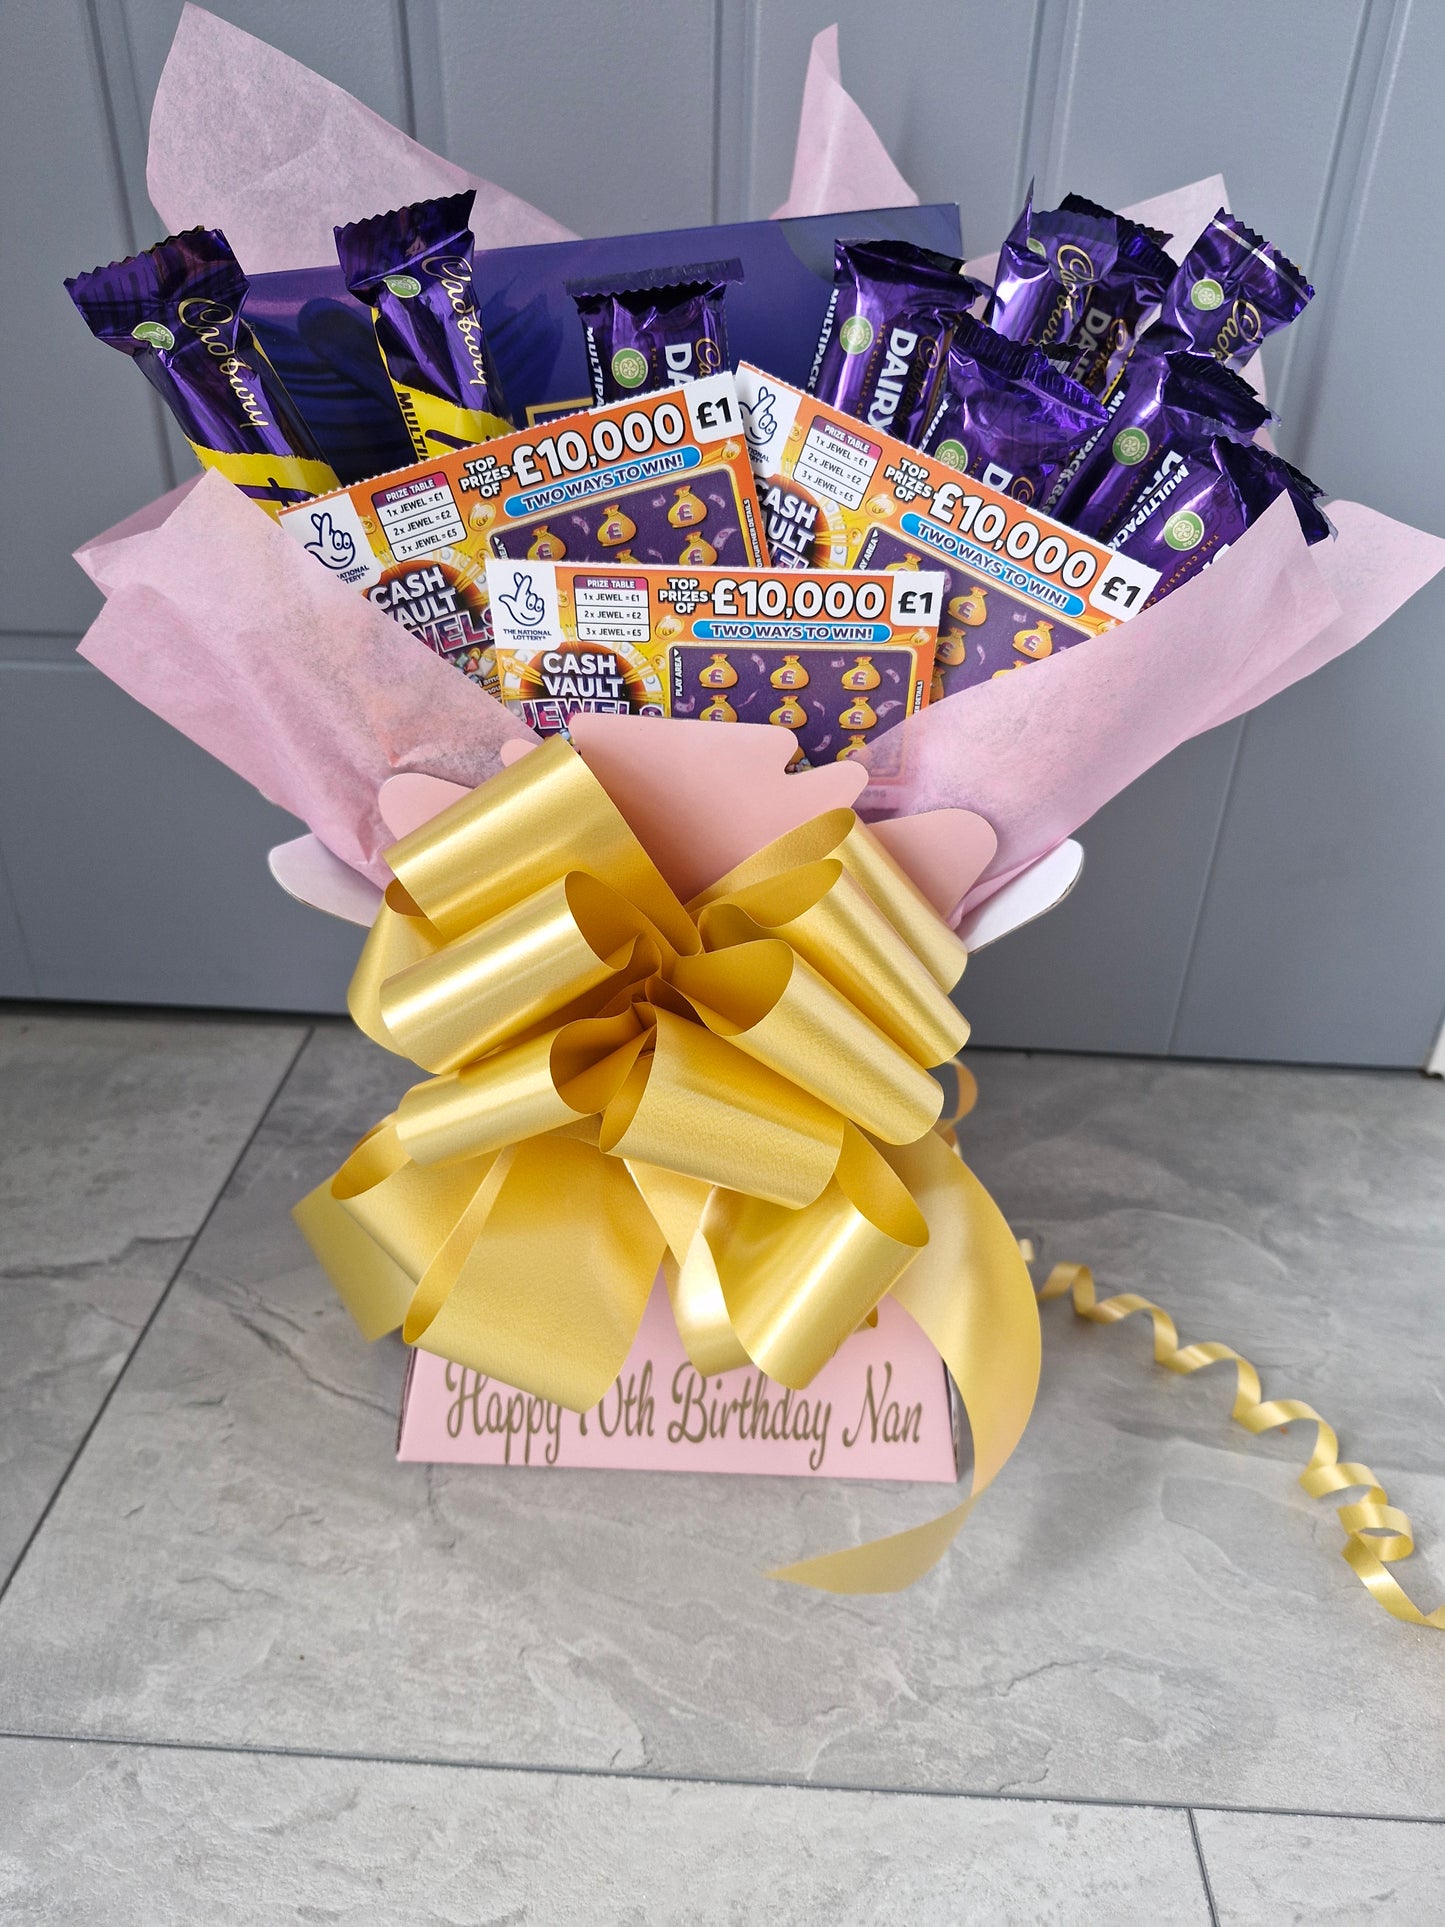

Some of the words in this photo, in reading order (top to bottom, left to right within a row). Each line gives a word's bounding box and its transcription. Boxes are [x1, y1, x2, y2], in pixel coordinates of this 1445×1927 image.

[807, 288, 840, 389] MULTIPACK
[178, 297, 269, 429] Cadbury
[867, 327, 918, 434] DAIRY
[696, 397, 732, 429] £1
[512, 403, 685, 486] £10,000
[824, 424, 845, 442] PRIZE
[846, 436, 870, 454] TABLE
[826, 443, 852, 460] JEWEL
[465, 456, 496, 476] TOP
[819, 460, 845, 477] JEWEL
[900, 459, 930, 481] TOP
[459, 464, 511, 492] PRIZES
[523, 486, 565, 510] TWO
[566, 474, 614, 498] WAYS
[616, 465, 640, 483] TO
[640, 454, 683, 476] WIN!
[813, 477, 839, 494] JEWEL
[884, 466, 934, 499] PRIZES
[385, 487, 409, 502] PRIZE
[410, 479, 435, 495] TABLE
[480, 482, 502, 499] OF
[895, 487, 917, 503] OF
[400, 498, 428, 515] JEWEL
[407, 517, 434, 533] JEWEL
[930, 483, 1097, 588] £10,000
[414, 534, 441, 552] JEWEL
[864, 540, 878, 561] AREA
[917, 522, 957, 552] TWO
[958, 543, 1003, 575] WAYS
[1004, 566, 1027, 587] TO
[1027, 577, 1068, 608] WIN!
[369, 564, 446, 610] CASH
[587, 579, 609, 588] PRIZE
[611, 580, 635, 589] TABLE
[668, 578, 699, 590] TOP
[1100, 576, 1141, 608] £1
[596, 593, 623, 602] JEWEL
[659, 589, 709, 602] PRIZES
[711, 578, 886, 620] £10,000
[897, 591, 933, 615] £1
[597, 610, 624, 619] JEWEL
[675, 602, 695, 614] OF
[517, 628, 552, 637] NATIONAL
[599, 628, 625, 637] JEWEL
[711, 624, 751, 638] TWO
[752, 625, 802, 639] WAYS
[805, 626, 831, 639] TO
[831, 627, 873, 640] WIN!
[542, 653, 616, 676] CASH
[541, 675, 624, 698] VAULT
[446, 1361, 562, 1464] Happy
[580, 1360, 655, 1437] 0th
[667, 1361, 832, 1471] Birthday
[842, 1361, 923, 1448] Nan
